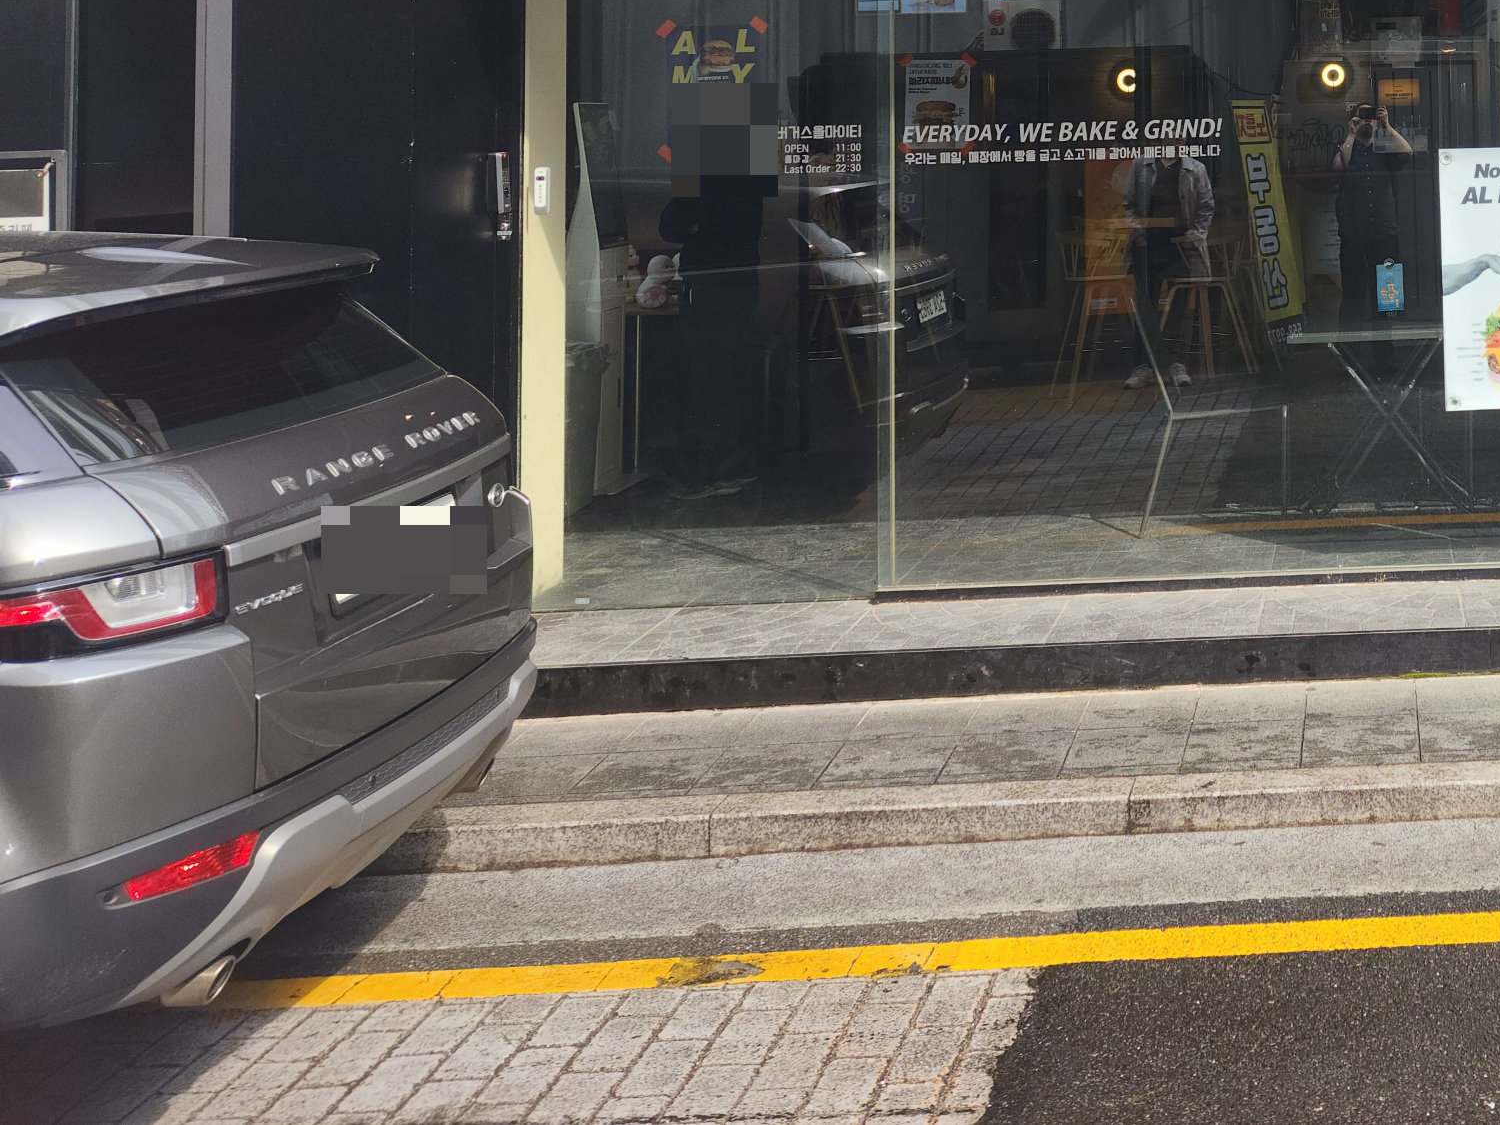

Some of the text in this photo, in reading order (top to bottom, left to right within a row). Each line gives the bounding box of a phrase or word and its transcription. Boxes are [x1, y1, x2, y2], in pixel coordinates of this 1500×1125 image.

[902, 118, 1223, 144] EVERYDAY, WE BAKE & GRIND!
[784, 143, 862, 154] OPEN 11:00
[836, 153, 862, 162] 21:30
[904, 152, 937, 165] 우리는
[968, 150, 1012, 164] 매장에서
[1014, 150, 1036, 162] 빵을
[1039, 149, 1061, 162] 굽고
[1063, 147, 1107, 161] 소고기를
[1109, 146, 1141, 160] 갈아서
[1143, 145, 1176, 158] 패티를
[1178, 144, 1222, 158] 만듭니다
[784, 163, 862, 174] Last Order 22:30
[1461, 186, 1493, 204] AL
[271, 410, 481, 496] RANGE ROVER
[233, 583, 304, 615] EVOQUE
